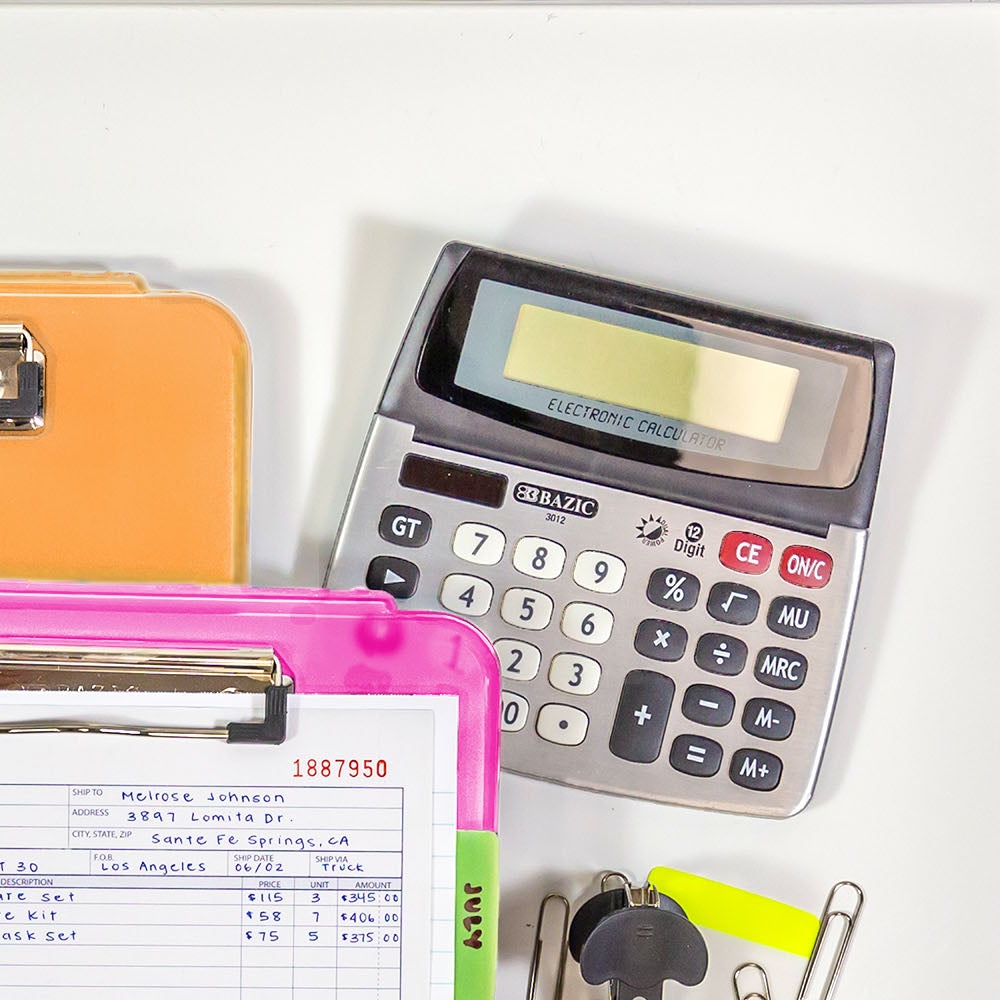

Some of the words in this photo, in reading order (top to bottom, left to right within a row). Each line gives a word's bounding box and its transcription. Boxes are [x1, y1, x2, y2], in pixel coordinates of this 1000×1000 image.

[548, 398, 634, 429] ELECTRONIC
[638, 420, 726, 451] CALCULATOR
[540, 489, 596, 516] BAZIC
[392, 516, 421, 538] GT
[545, 513, 566, 525] 3012
[674, 539, 705, 557] Digit
[736, 542, 762, 565] CE
[472, 533, 489, 555] 7
[532, 547, 548, 570] 8
[594, 561, 609, 583] 9
[787, 555, 826, 581] ON/C
[459, 585, 475, 608] 4
[520, 597, 535, 621] 5
[581, 613, 595, 636] 6
[778, 605, 809, 629] MU
[507, 650, 523, 673] 2
[569, 663, 583, 686] 3
[760, 655, 801, 681] MRC
[504, 701, 519, 724] 0
[755, 707, 780, 728] M-
[293, 759, 387, 778] 1887950
[740, 757, 769, 778] M+
[122, 791, 193, 803] Melrose
[207, 791, 284, 803] Johnson
[127, 811, 176, 822] 3897
[192, 812, 253, 822] Lomita
[265, 812, 293, 823] Dr.
[72, 831, 92, 839] CITY,
[93, 831, 118, 839] STATE,
[152, 834, 207, 845] Sante
[216, 834, 238, 845] Fe
[328, 836, 349, 847] CA
[17, 862, 38, 872] 30
[234, 854, 252, 862] SHIP
[102, 861, 129, 871] Los
[140, 862, 205, 876] Angeles
[235, 863, 284, 872] 06/02
[323, 863, 364, 873] Truck
[0, 878, 53, 886] DESCRIPTION
[311, 893, 320, 903] 3
[341, 892, 375, 904] $345
[312, 911, 320, 923] 7
[463, 883, 482, 949] JULY
[309, 931, 319, 942] 5
